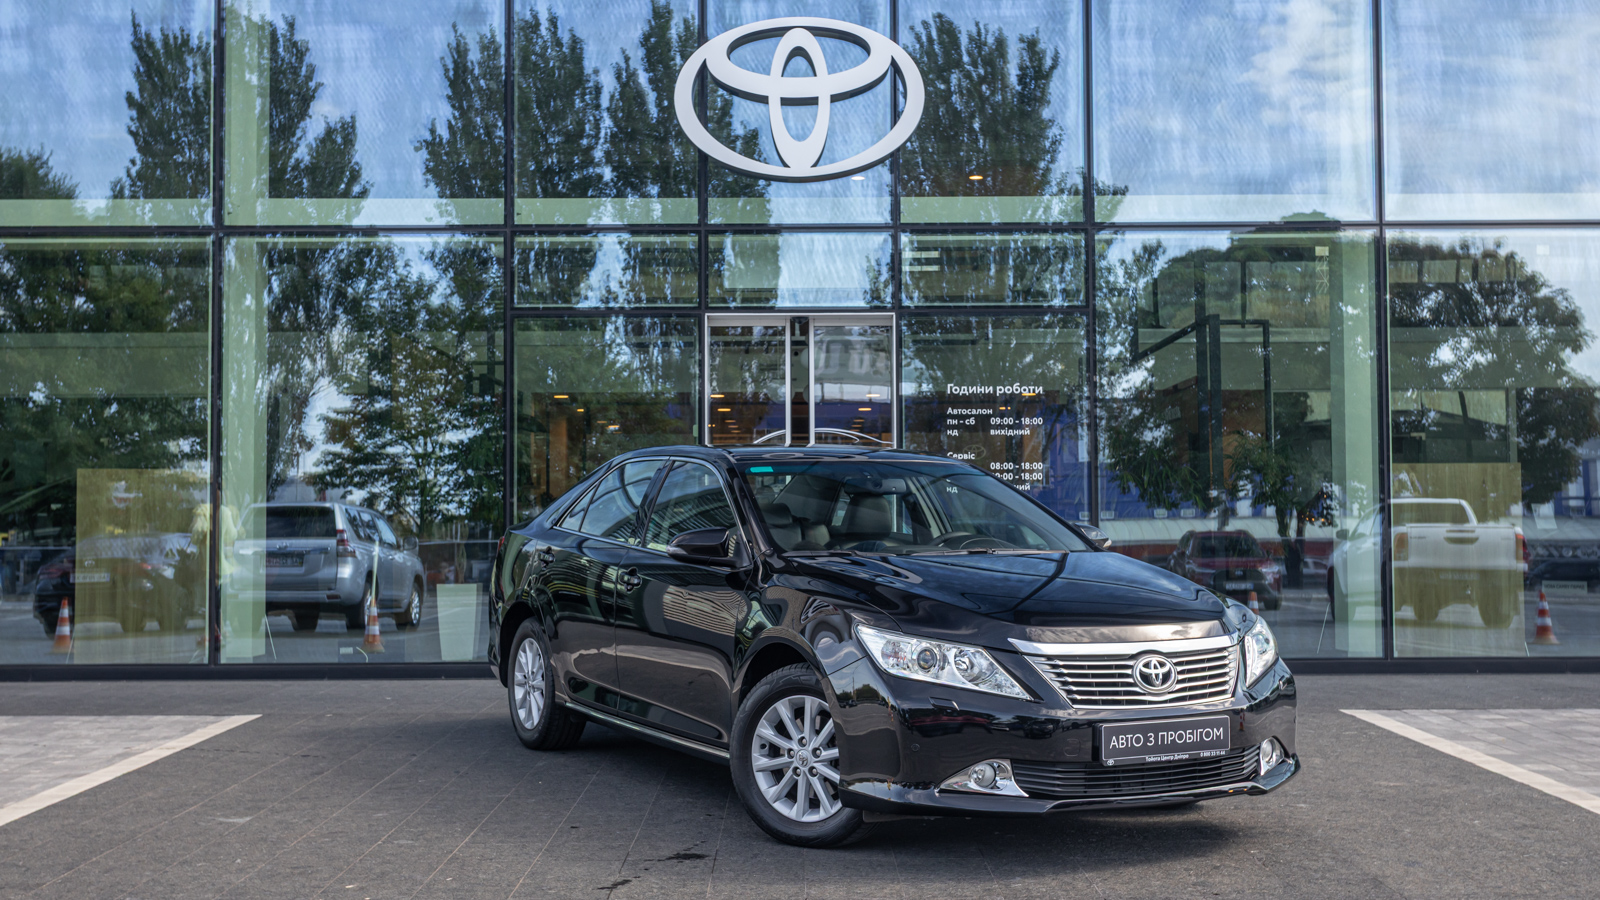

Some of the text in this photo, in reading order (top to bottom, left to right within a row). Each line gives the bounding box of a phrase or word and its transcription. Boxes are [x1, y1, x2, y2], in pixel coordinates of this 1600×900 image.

[947, 382, 1043, 397] Години роботи
[946, 407, 993, 415] Автосалон
[965, 417, 976, 426] сб
[990, 417, 1014, 425] 09:00
[1021, 417, 1043, 425] 18:00
[990, 427, 1031, 436] вихідний
[990, 462, 1014, 470] 08:00
[1021, 462, 1043, 470] 18:00
[1021, 472, 1043, 480] 18:00
[946, 486, 959, 494] нд
[1109, 727, 1224, 749] АВТО З ПРОБІГОМ
